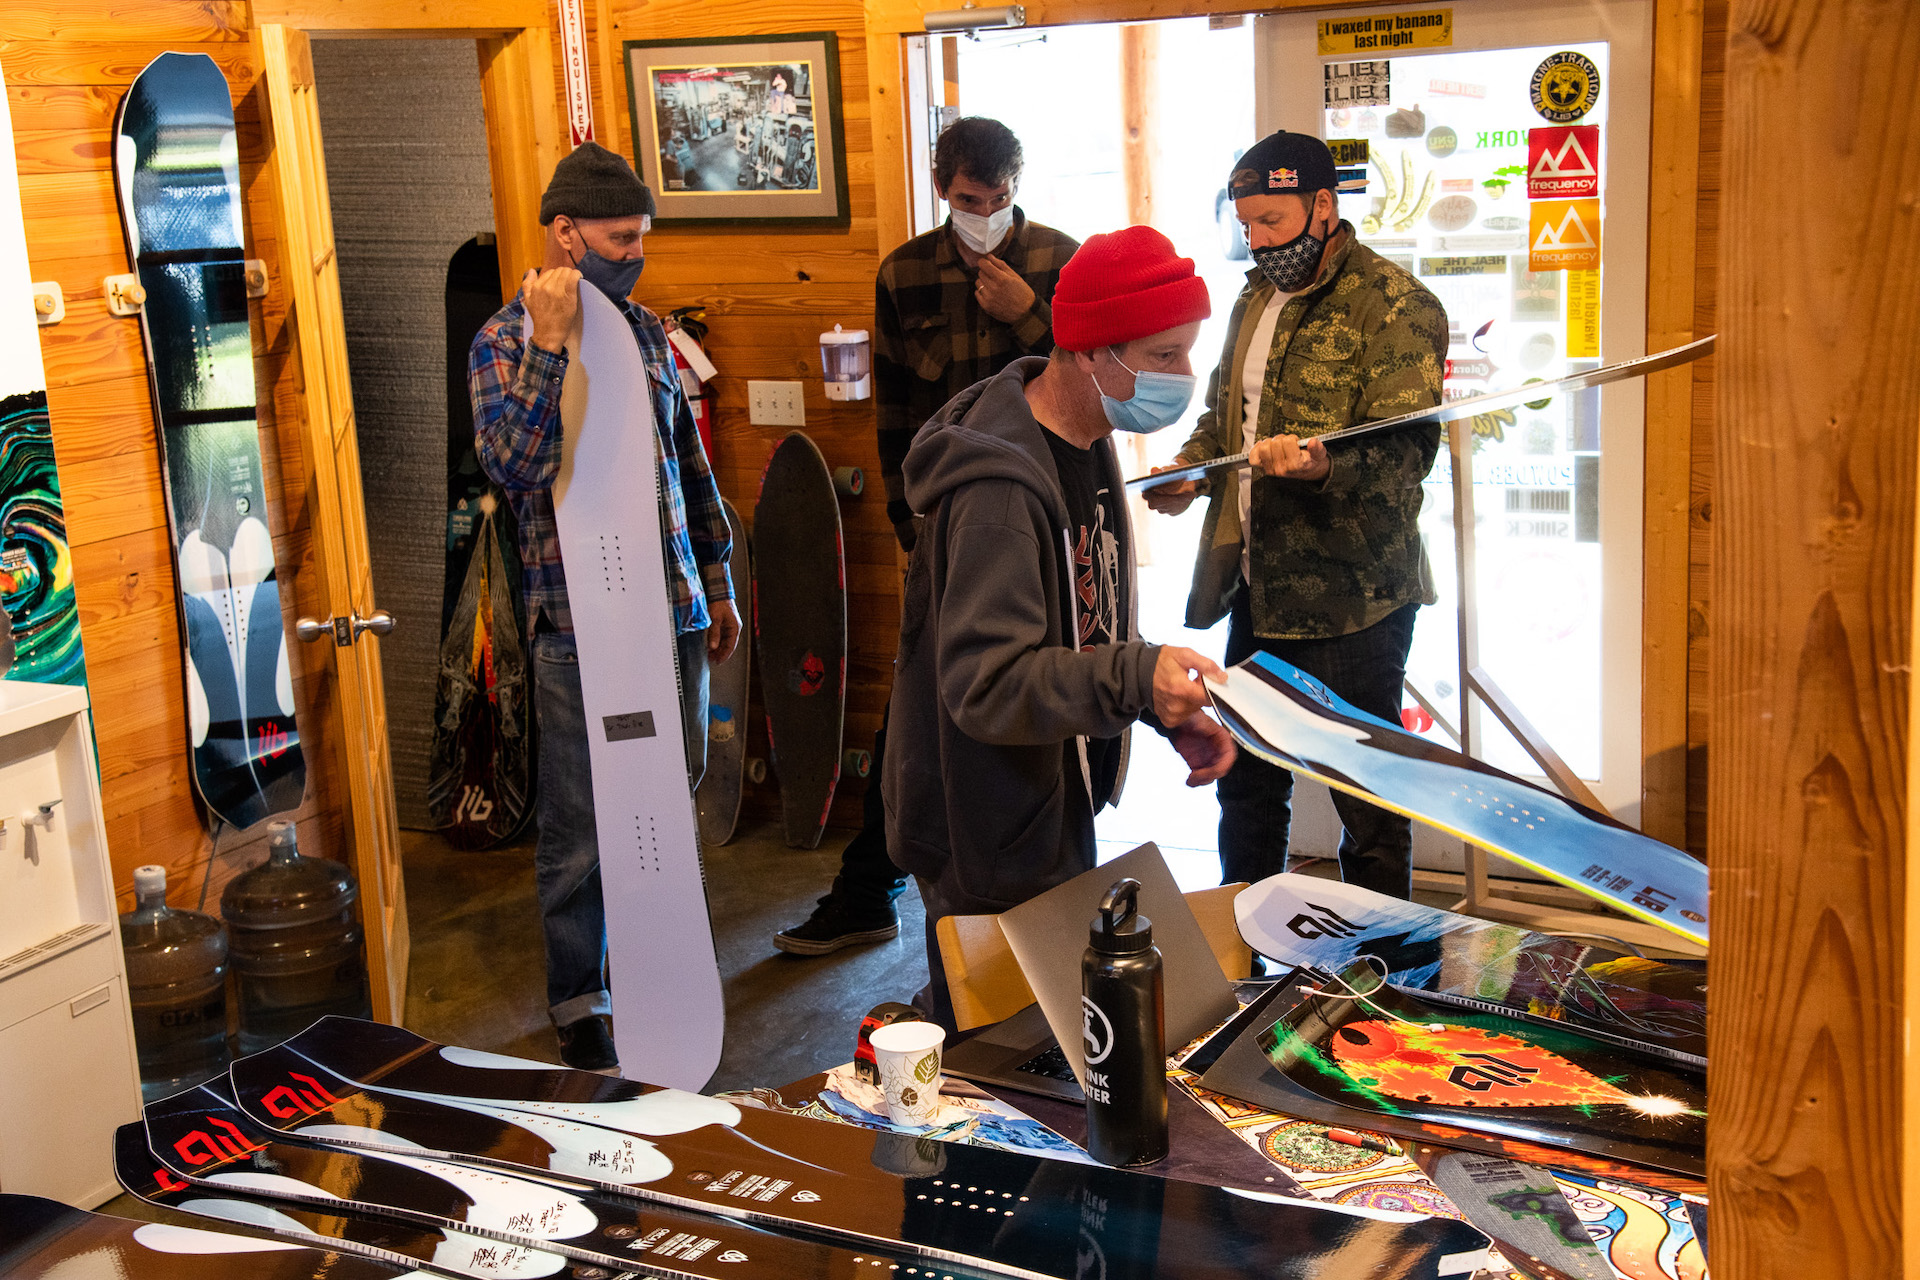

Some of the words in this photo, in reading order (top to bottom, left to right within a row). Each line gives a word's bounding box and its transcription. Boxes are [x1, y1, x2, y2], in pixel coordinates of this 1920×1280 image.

[1325, 22, 1330, 36] I
[1332, 19, 1371, 35] waxed
[1375, 19, 1393, 31] my
[1396, 14, 1443, 30] banana
[1354, 34, 1378, 48] last
[1380, 31, 1413, 47] night
[568, 0, 585, 135] EXTINGUISHER
[1334, 62, 1374, 78] LIB
[1531, 52, 1599, 105] MAGNE-TRACTION
[1334, 85, 1374, 101] LIB
[1269, 180, 1283, 188] Red
[1284, 179, 1298, 188] Bull
[1530, 179, 1597, 190] frequency
[1531, 252, 1597, 263] frequency
[1086, 1068, 1110, 1088] INK
[1086, 1083, 1111, 1104] TER
